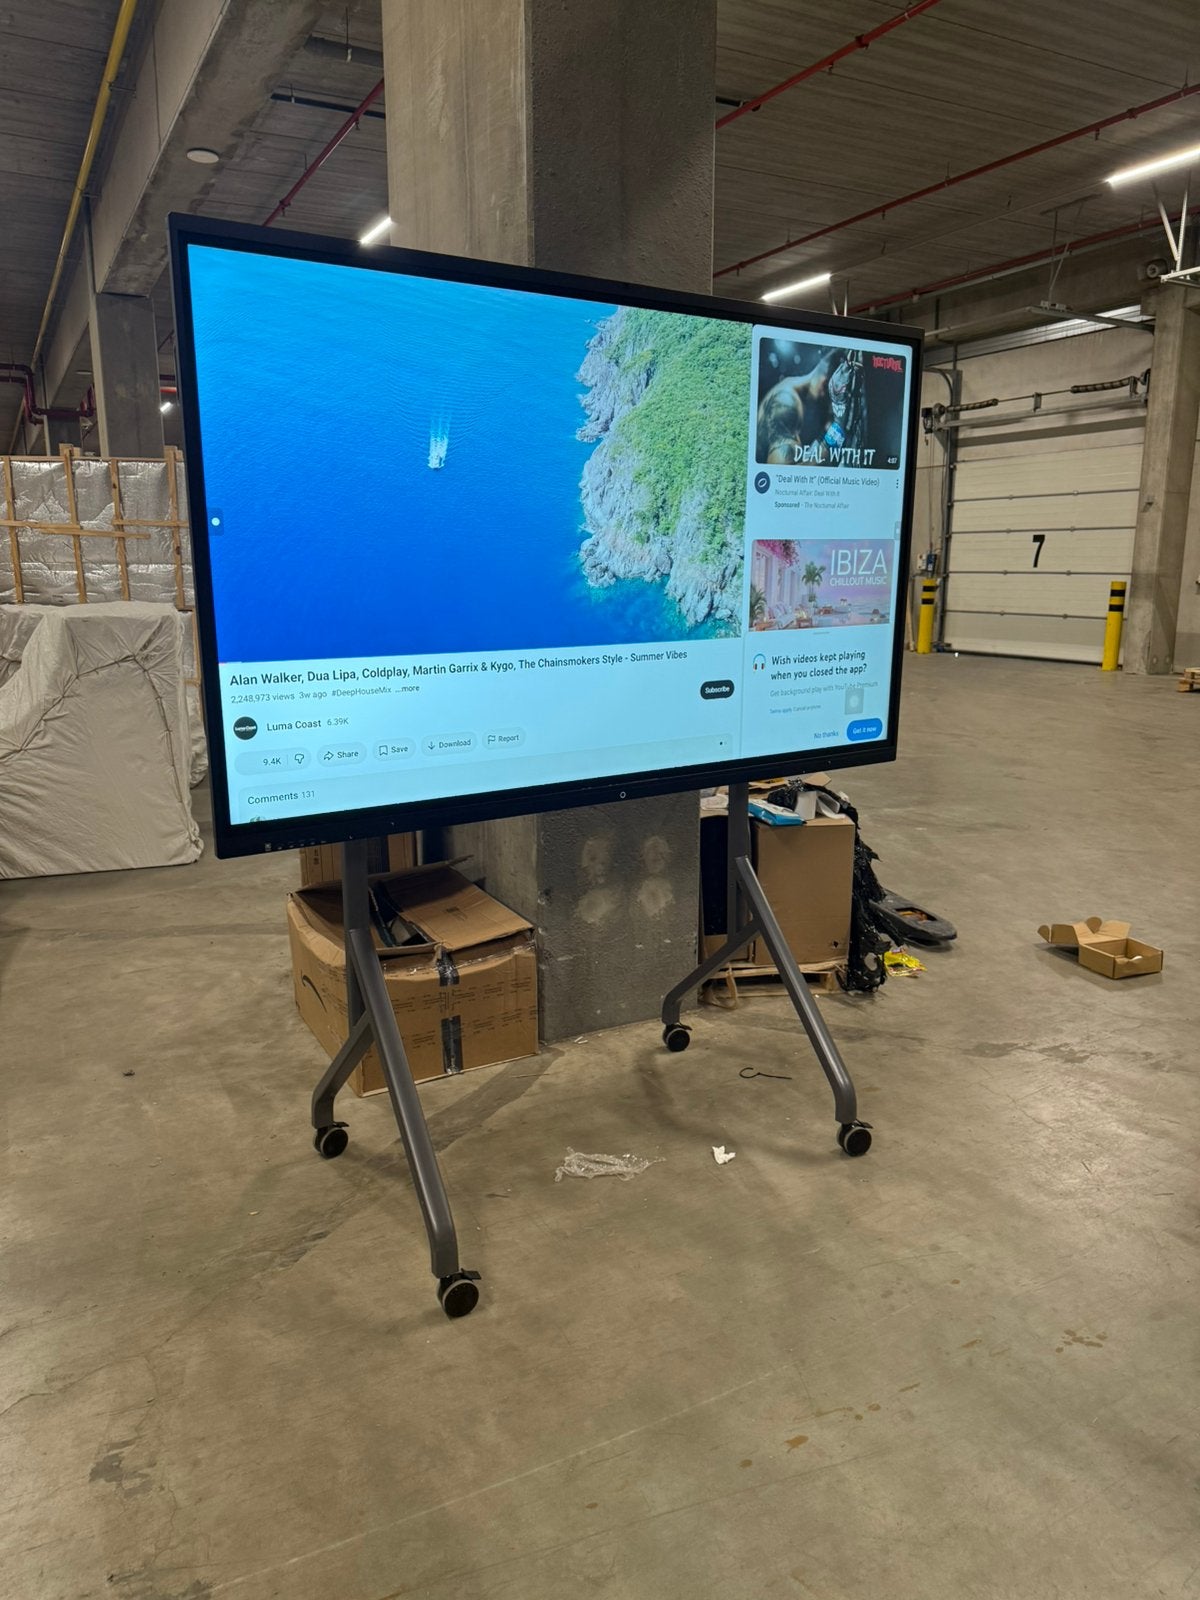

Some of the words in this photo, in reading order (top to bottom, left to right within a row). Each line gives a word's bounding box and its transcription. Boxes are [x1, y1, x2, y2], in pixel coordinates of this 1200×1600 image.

[794, 445, 825, 462] DEAL
[829, 447, 861, 464] WITH
[864, 449, 876, 465] IT
[794, 475, 808, 484] With
[818, 476, 841, 486] (Official
[842, 477, 860, 486] Music
[862, 478, 880, 487] Video)
[774, 501, 800, 509] Sponsored
[1032, 534, 1046, 568] 7
[830, 549, 888, 575] IBIZA
[829, 576, 864, 587] CHILLOUT
[865, 575, 888, 585] MUSIC
[772, 655, 791, 666] Wish
[793, 653, 817, 664] videos
[819, 652, 837, 664] kept
[839, 650, 866, 662] playing
[230, 674, 257, 686] Alan
[261, 672, 304, 684] Walker,
[308, 671, 330, 682] Dua
[333, 669, 359, 681] Lipa,
[362, 667, 410, 679] Coldplay,
[413, 664, 447, 676] Martin
[449, 662, 479, 673] Garrix
[481, 662, 488, 672] &
[490, 661, 516, 673] Kygo,
[518, 659, 536, 669] The
[538, 655, 600, 668] Chainsmokers
[602, 654, 623, 665] Style
[630, 651, 664, 662] Summer
[665, 650, 688, 660] Vibes
[771, 670, 792, 680] when
[794, 670, 808, 680] you
[809, 667, 834, 677] closed
[835, 666, 848, 675] the
[850, 664, 868, 675] app?
[231, 693, 271, 704] 2,248,973
[272, 692, 295, 701] views
[299, 691, 311, 699] 3w
[313, 690, 327, 699] ago
[331, 686, 392, 697] #DeepHouseMix
[705, 685, 730, 694] Subscribe
[780, 686, 811, 696] background
[267, 720, 293, 732] Luma
[295, 719, 322, 729] Coast
[326, 717, 349, 727] 6.39K
[438, 738, 471, 748] Download
[498, 734, 519, 744] Report
[337, 749, 359, 759] Share
[391, 744, 408, 753] Save
[263, 757, 282, 766] 9.4K
[248, 791, 298, 804] Comments
[301, 790, 315, 799] 131
